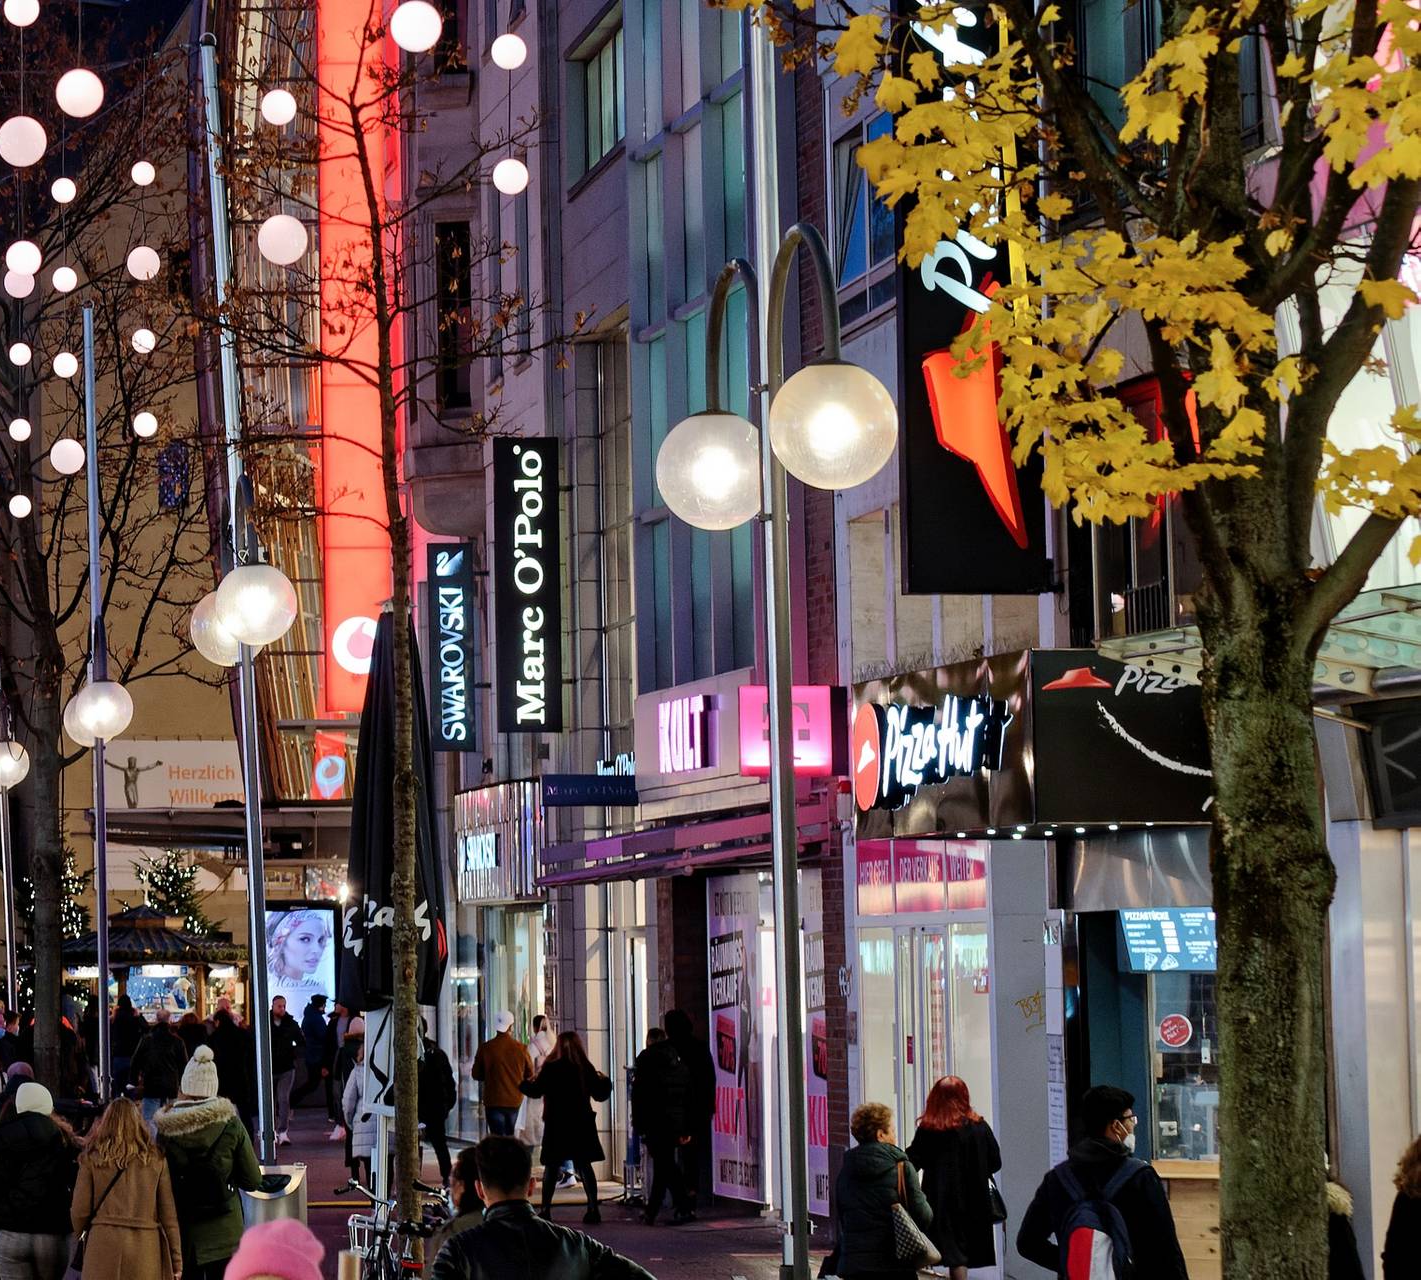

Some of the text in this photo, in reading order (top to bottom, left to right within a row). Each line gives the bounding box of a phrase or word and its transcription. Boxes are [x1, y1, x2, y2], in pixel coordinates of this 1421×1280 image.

[513, 445, 546, 725] Marc O'Polo
[438, 586, 467, 742] SWAROVSKI
[1114, 664, 1188, 696] Pizz
[168, 765, 235, 780] Herzlich
[658, 694, 705, 774] KULT
[883, 704, 938, 797] Pizza
[937, 694, 984, 777] Hut
